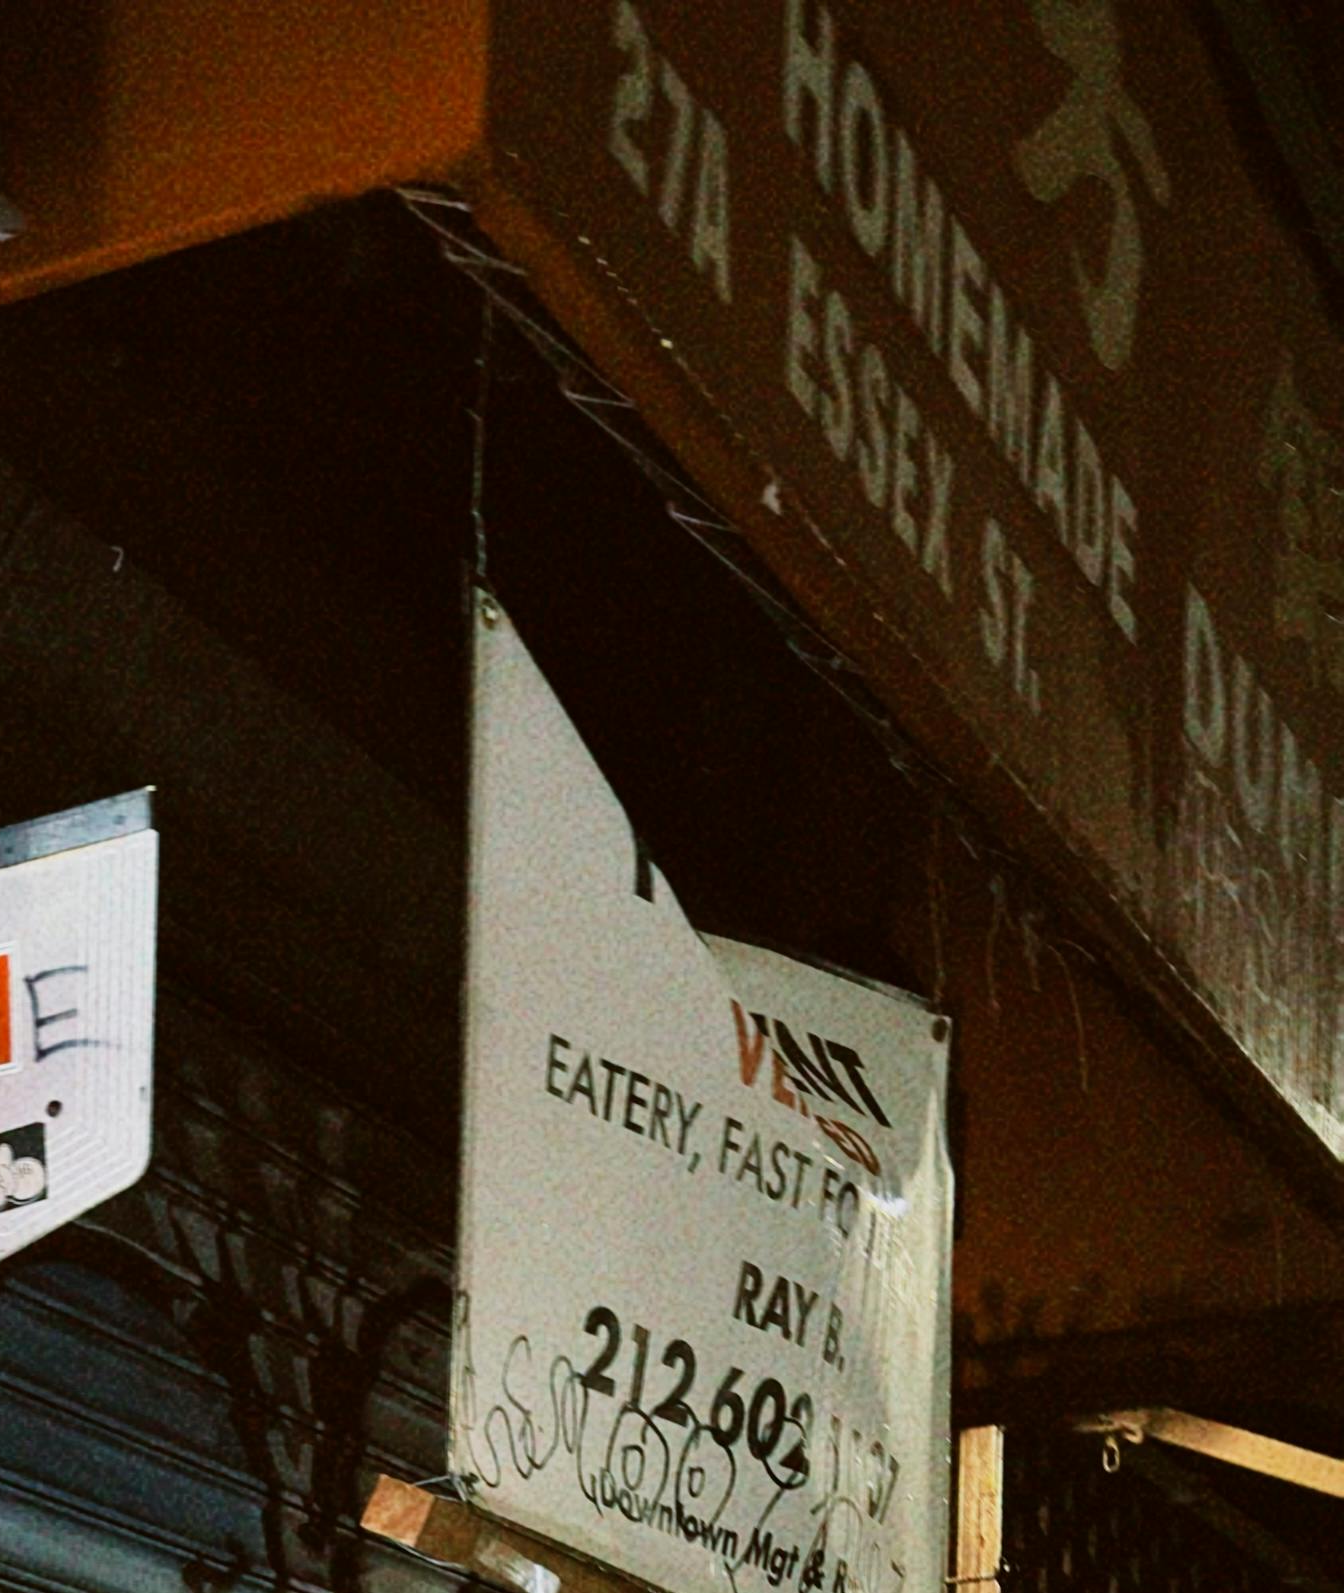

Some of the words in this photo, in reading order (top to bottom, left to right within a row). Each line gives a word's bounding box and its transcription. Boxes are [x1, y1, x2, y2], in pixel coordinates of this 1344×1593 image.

[543, 1031, 703, 1176] EATERY,
[718, 1115, 812, 1214] FAST
[733, 1260, 820, 1347] RAY
[744, 1524, 797, 1580] Mgt
